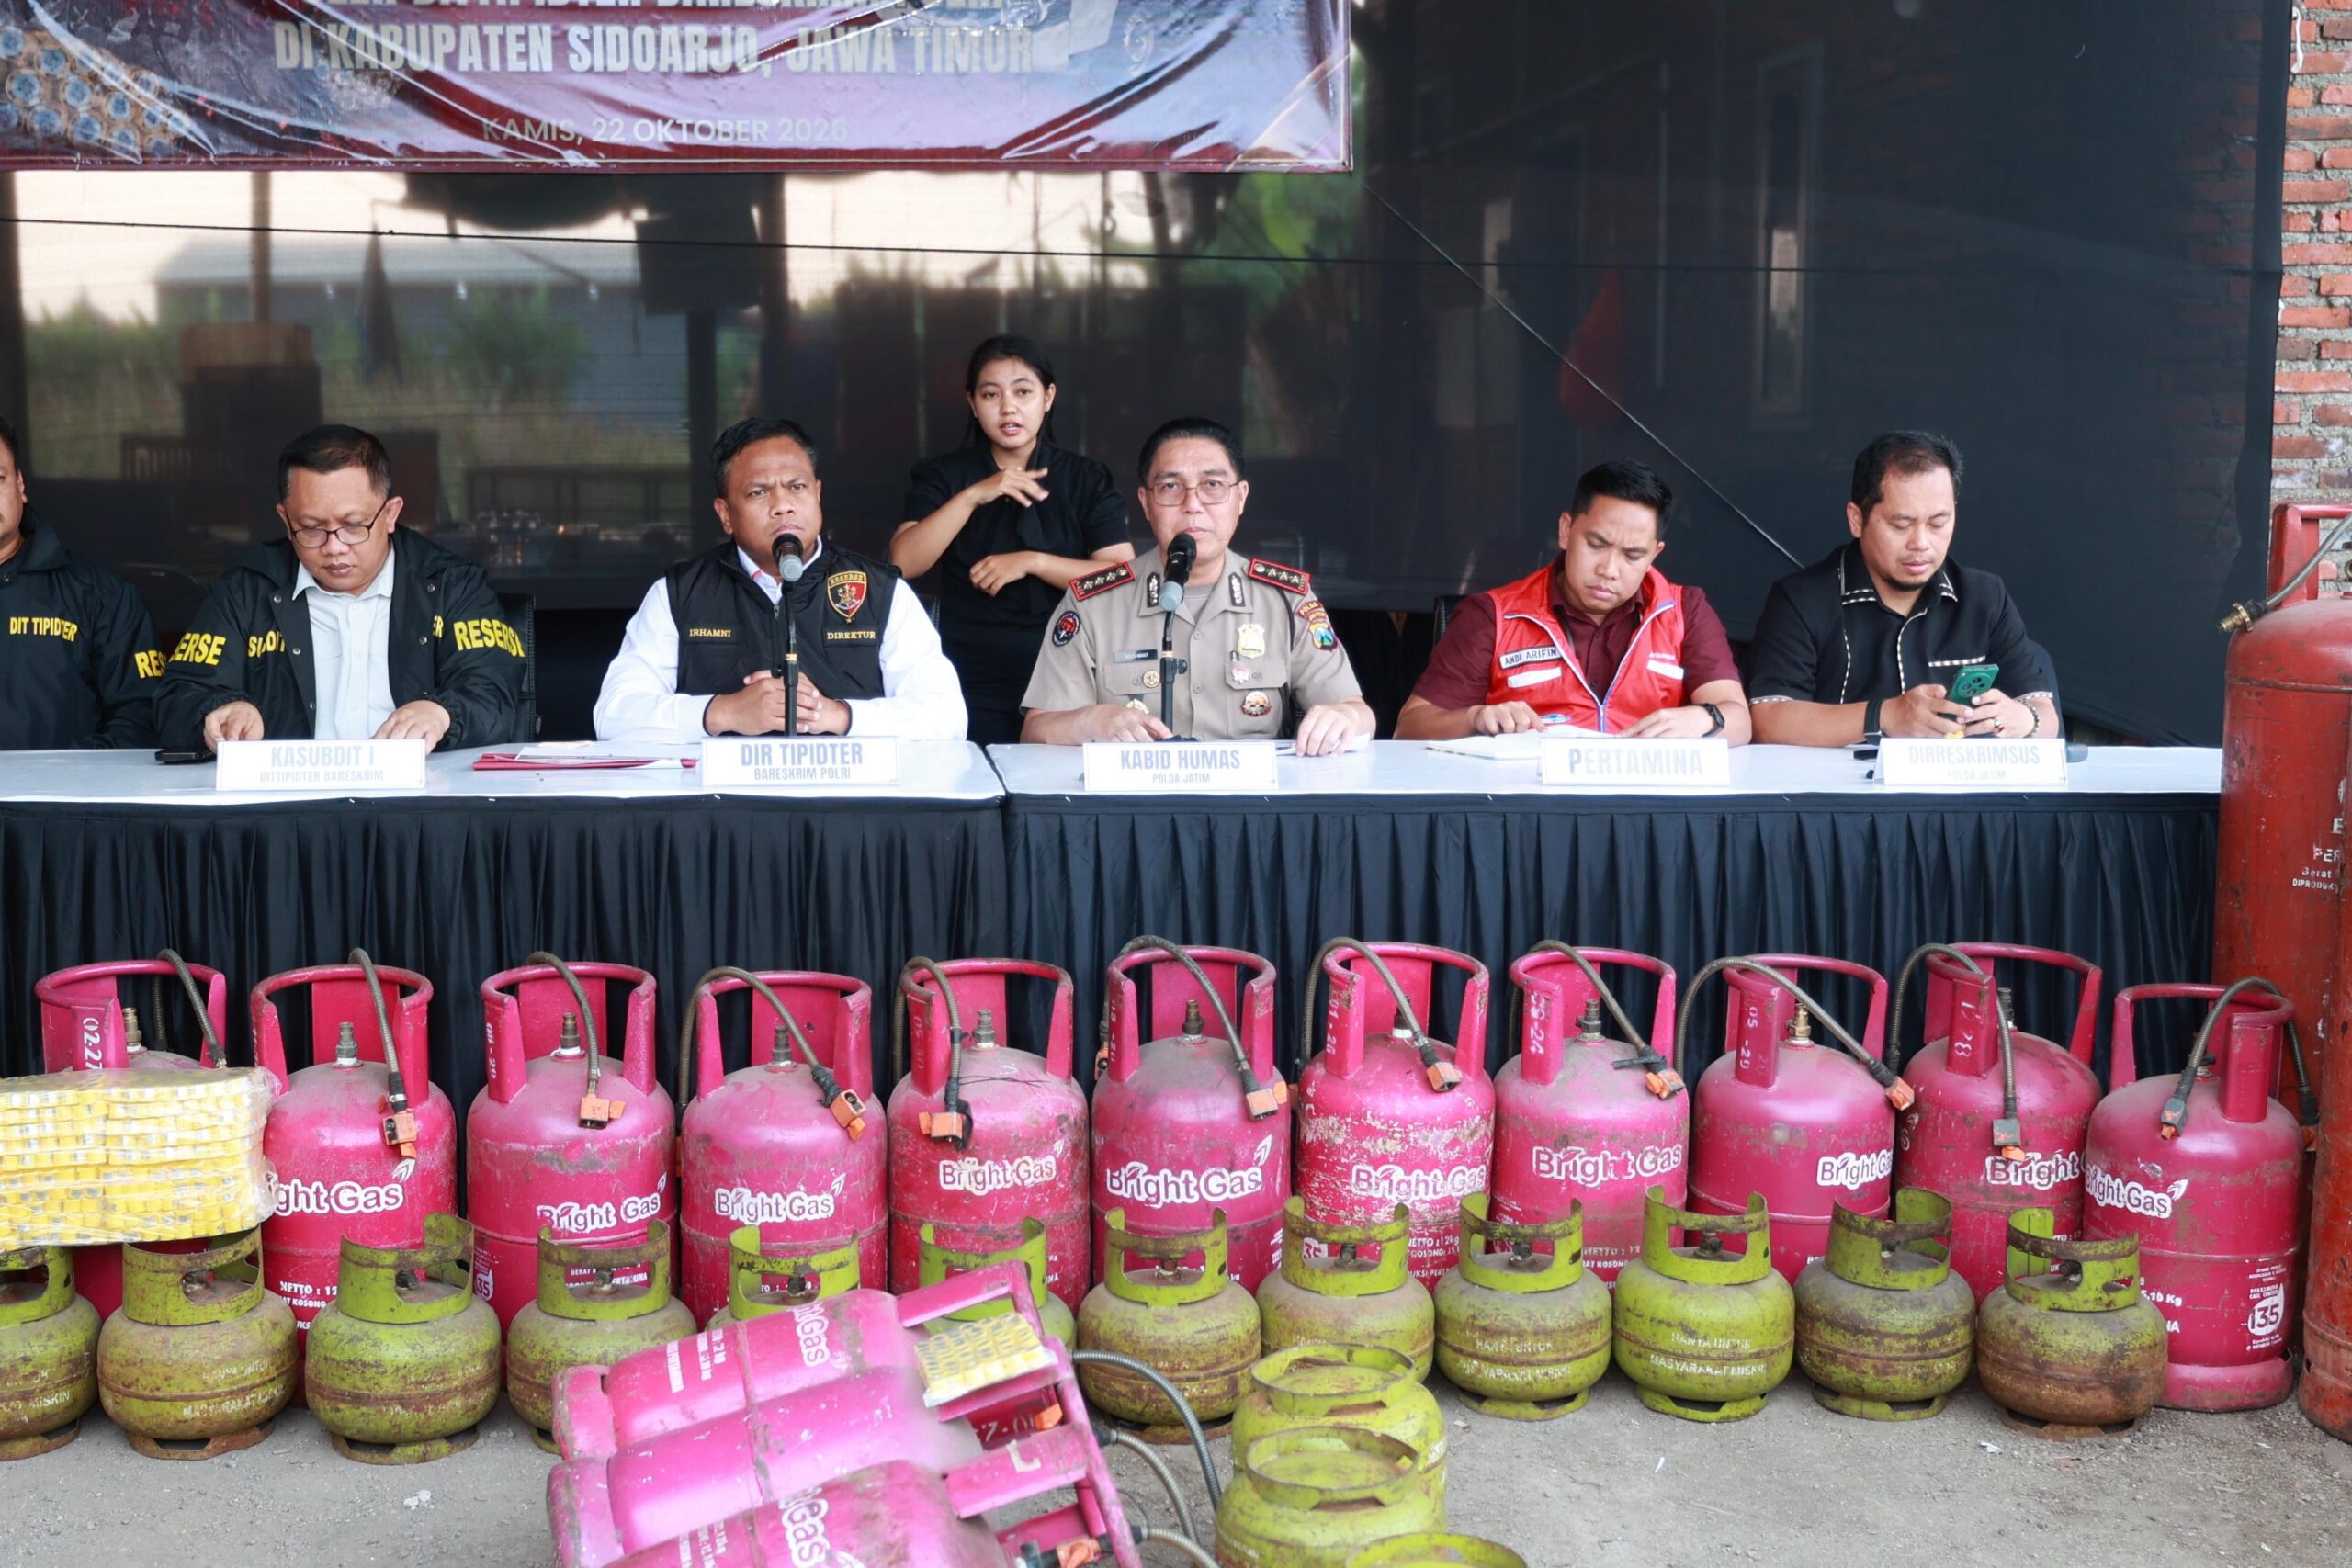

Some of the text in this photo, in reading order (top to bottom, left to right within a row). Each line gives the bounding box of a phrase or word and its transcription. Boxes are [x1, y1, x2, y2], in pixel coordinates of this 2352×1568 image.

[276, 22, 1034, 77] DI KABUPATEN SIDOARJO, JAWA TIMUR
[481, 118, 583, 145] KAMIS,
[592, 118, 625, 141] 22
[633, 118, 769, 142] OKTOBER
[9, 616, 78, 642] DIT TIPIDTER
[689, 628, 731, 637] IRHAMNI
[827, 631, 876, 640] DIREKTUR
[169, 633, 227, 665] ERSE
[1504, 647, 1557, 667] ANDI ARIFIN
[270, 745, 375, 768] KASUBDIT I
[741, 742, 864, 766] DIR TIPIDTER
[1120, 749, 1241, 770] KABID HUMAS
[1568, 748, 1703, 775] PERTAMINA
[1908, 744, 2041, 764] DIRRESKRIMSUS
[260, 770, 384, 783] DITTIPIDTER BARESKRIM
[754, 767, 852, 781] BARESKRIM POLRI
[1152, 773, 1211, 784] POLDA JATIM
[2250, 1303, 2280, 1330] 135
